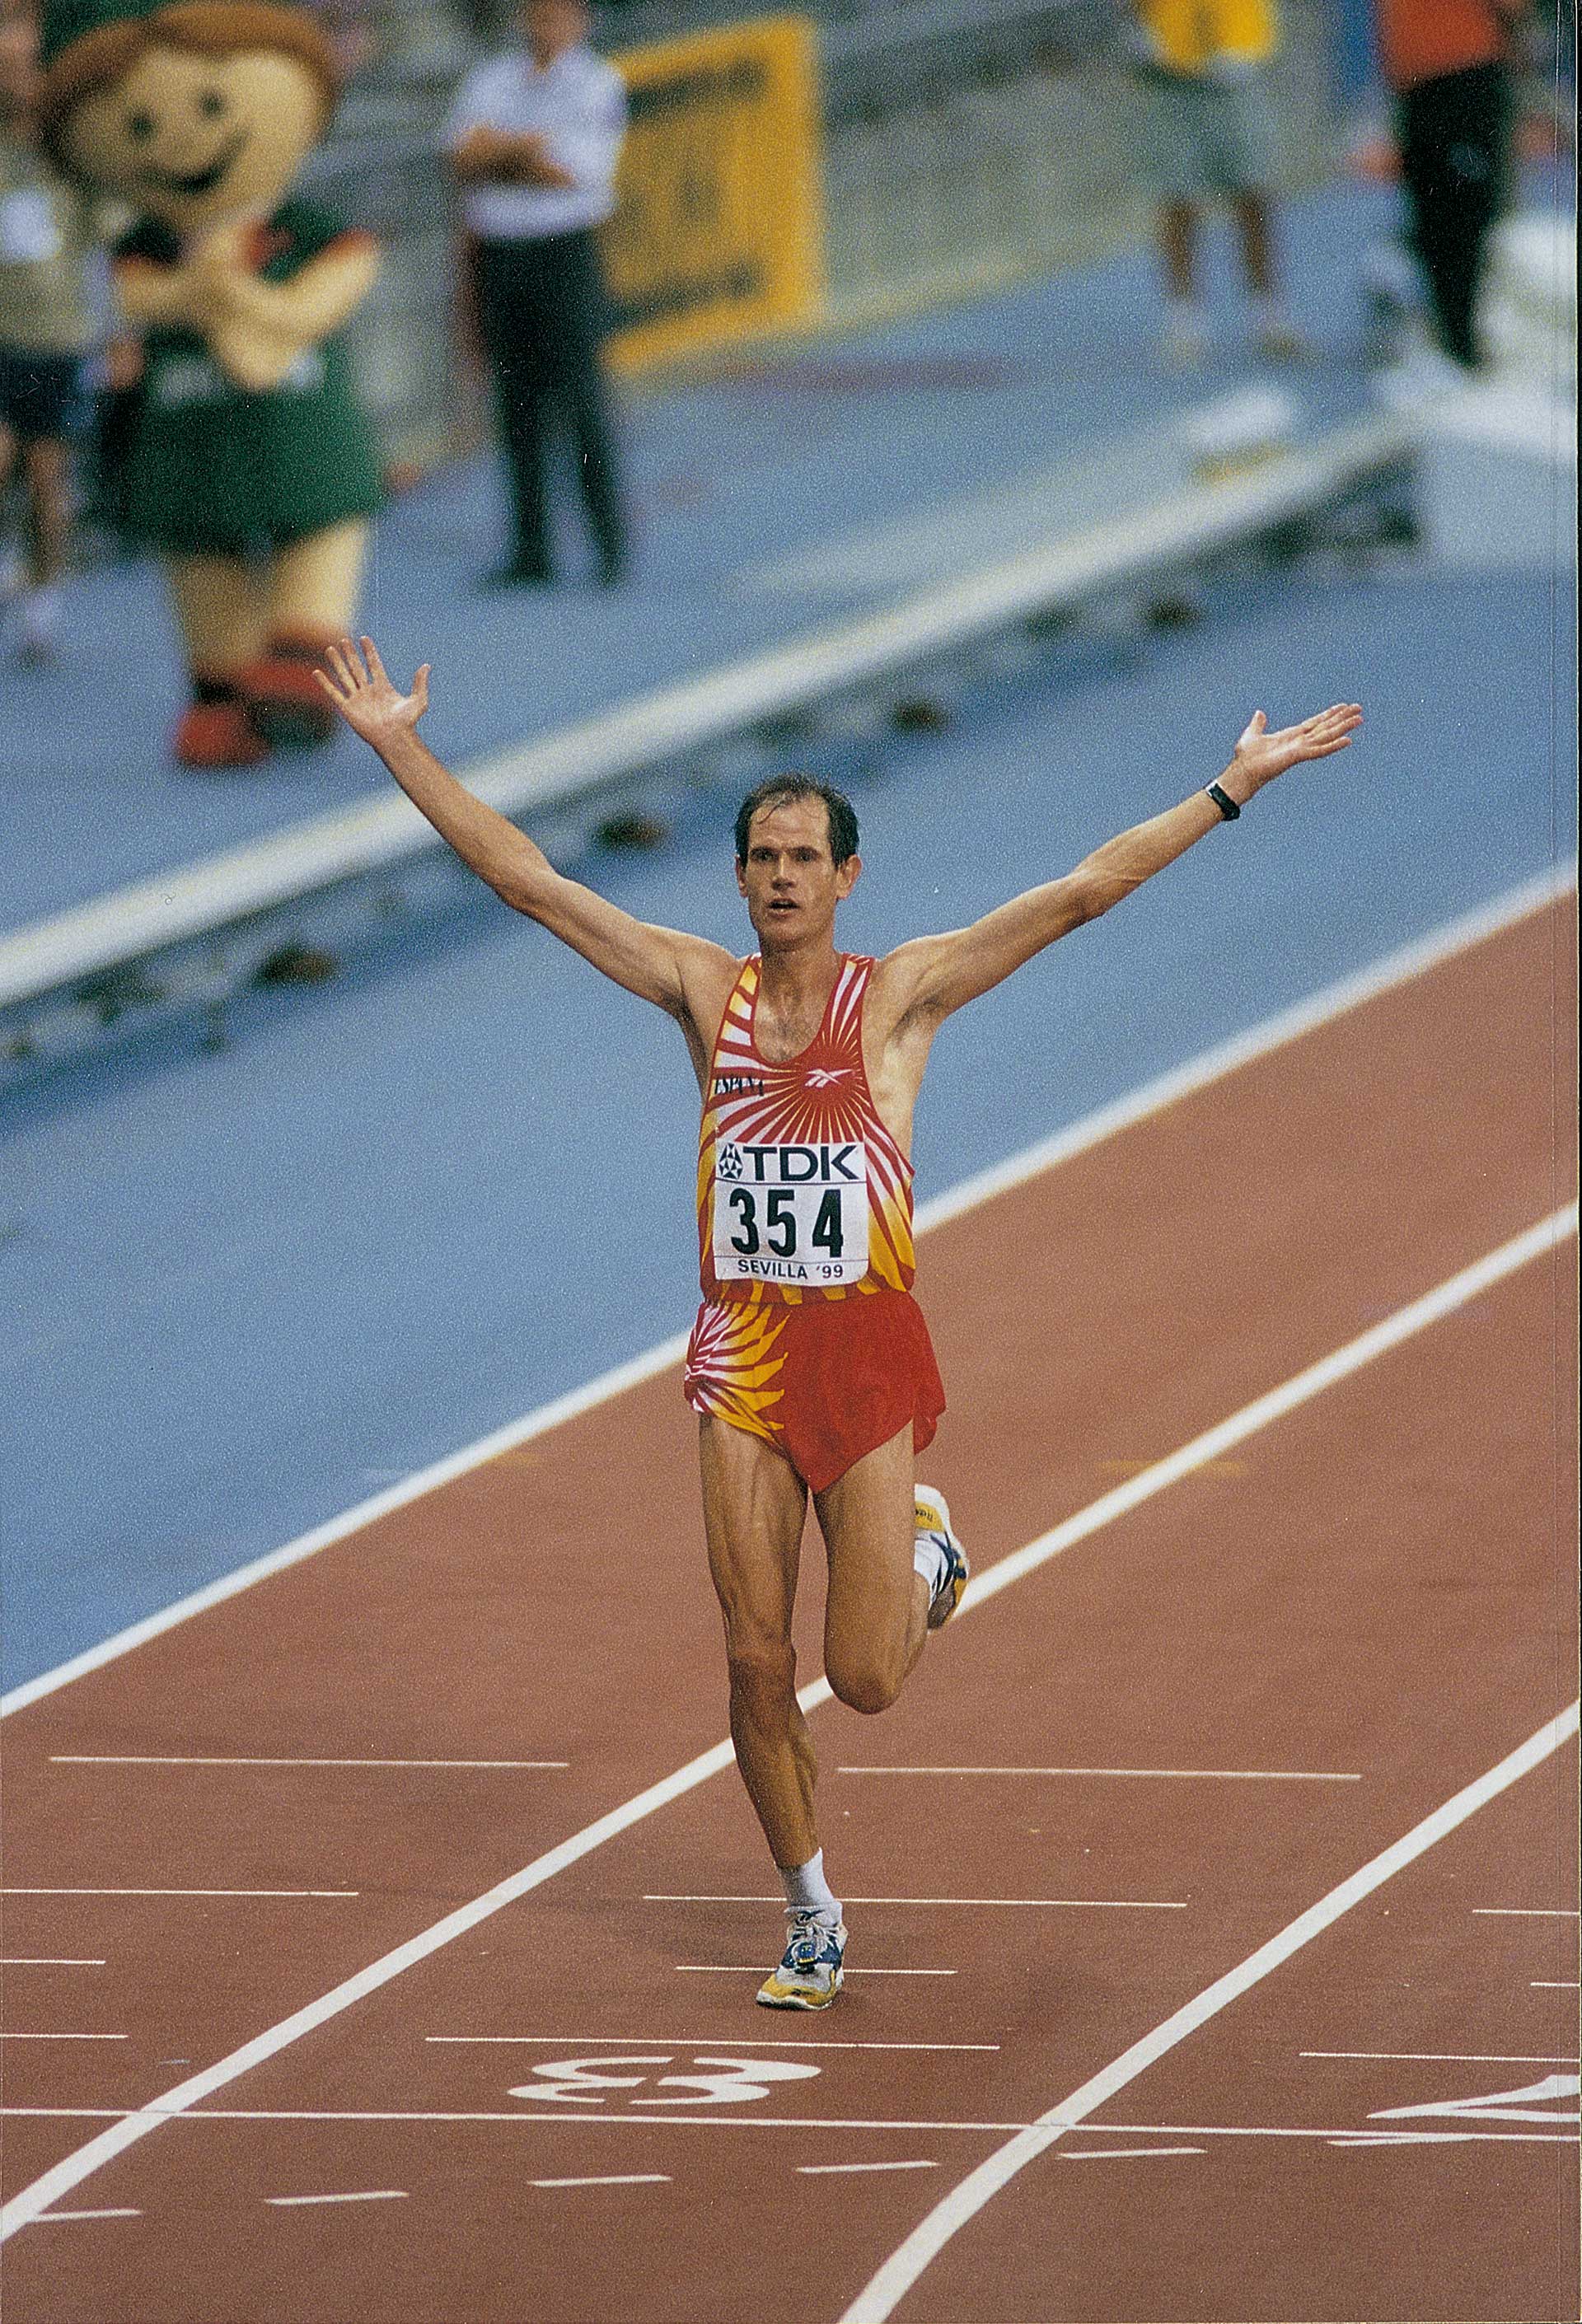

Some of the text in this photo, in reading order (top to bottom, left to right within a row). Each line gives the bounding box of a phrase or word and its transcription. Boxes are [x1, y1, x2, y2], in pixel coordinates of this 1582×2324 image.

[742, 1144, 860, 1181] TDK
[729, 1188, 844, 1258] 354
[738, 1260, 843, 1279] SEVILLA '99
